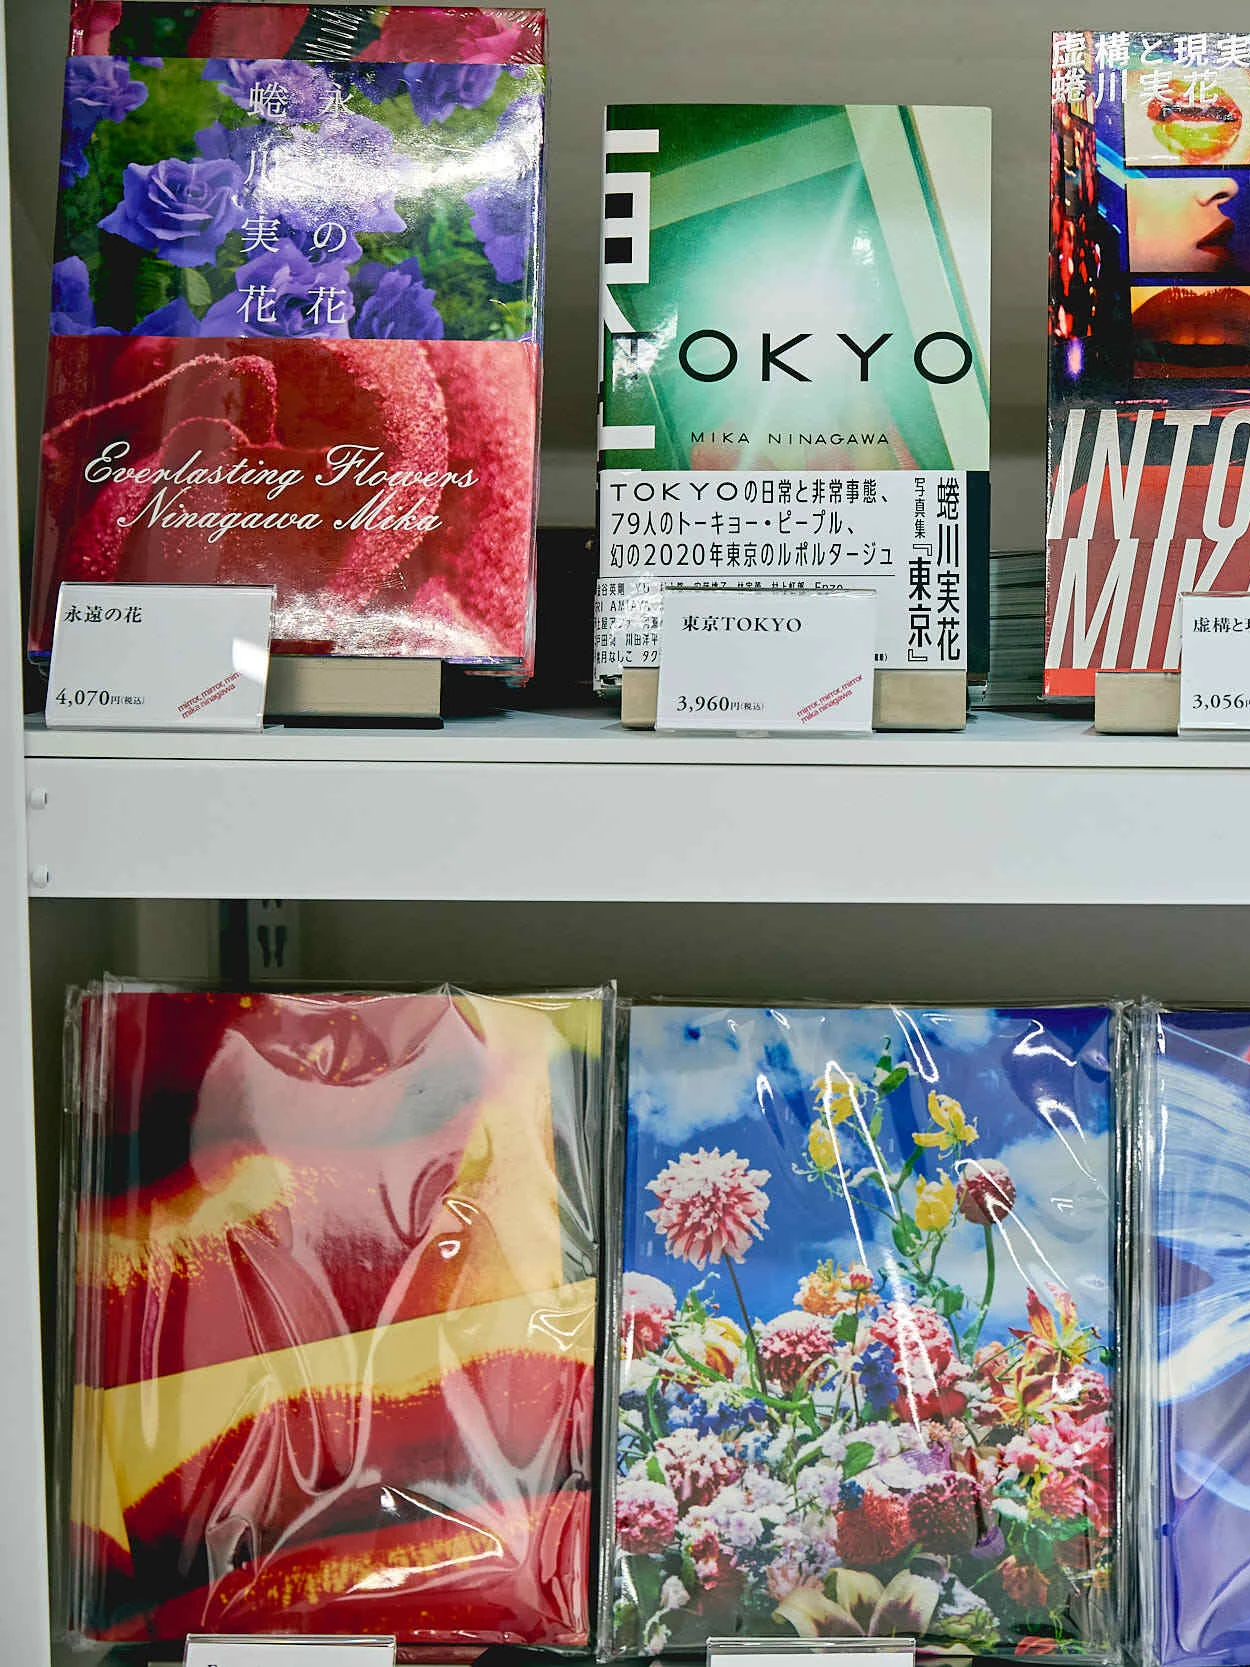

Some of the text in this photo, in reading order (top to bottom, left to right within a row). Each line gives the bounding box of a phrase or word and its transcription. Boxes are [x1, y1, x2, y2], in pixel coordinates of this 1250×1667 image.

[1052, 68, 1218, 108] 蜷川実花
[236, 81, 288, 324] 蜷川実花
[305, 84, 355, 325] 永の花
[690, 430, 890, 445] MIKA NINAGAWA
[84, 441, 480, 500] Everlasting Flowers
[609, 478, 889, 504] TOKYOの日常と非常事態、
[116, 486, 444, 544] Ninagawa Mika
[611, 509, 855, 536] 79人のトーキョー・ピープル、
[610, 541, 894, 568] 幻の2020年東京のルポルタージュ
[907, 477, 933, 662] 写真集『東京』
[936, 476, 961, 662] 蜷川実花
[64, 605, 143, 624] 永遠の花
[680, 615, 802, 633] 東京TOKYO
